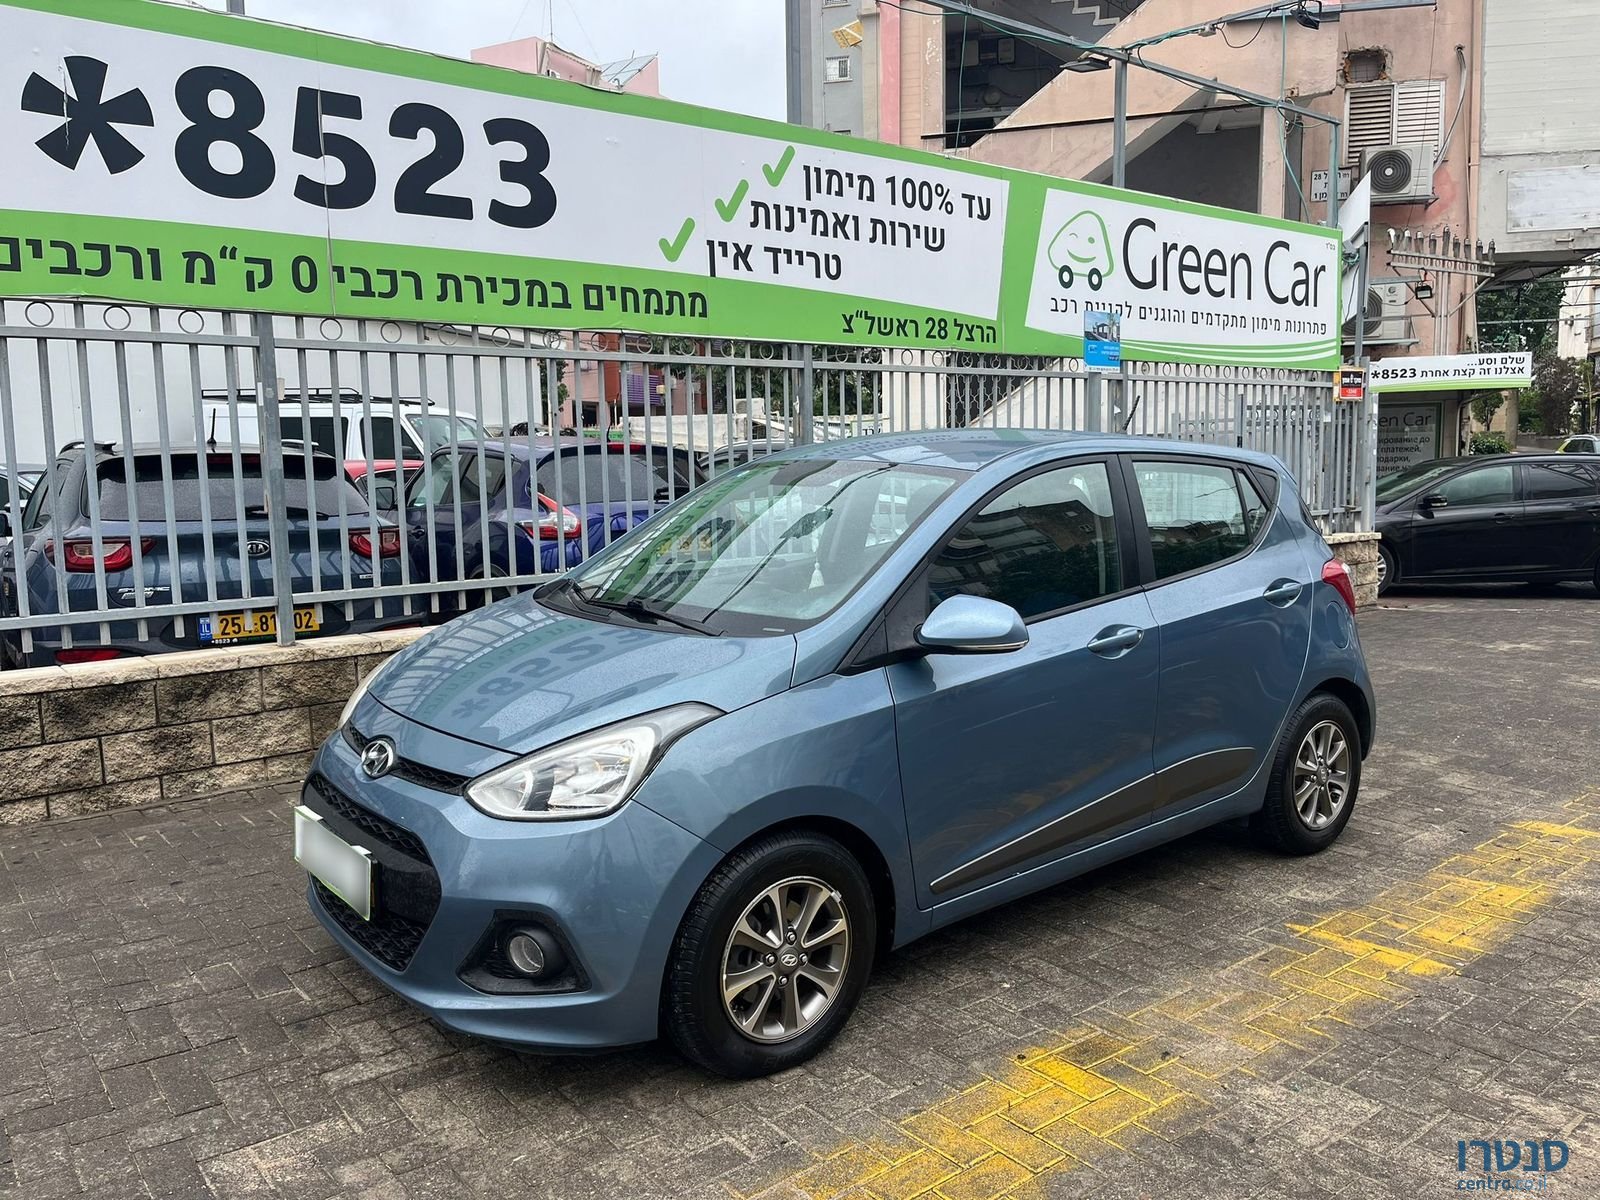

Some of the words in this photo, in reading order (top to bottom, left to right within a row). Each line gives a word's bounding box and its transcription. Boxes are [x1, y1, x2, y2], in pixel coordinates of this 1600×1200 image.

[803, 164, 875, 201] מימון
[885, 176, 954, 215] 100%
[961, 193, 991, 221] עד
[749, 200, 860, 242] ואמינות
[869, 218, 945, 253] שירות
[0, 237, 163, 281] ורכבים
[706, 239, 753, 278] אין
[764, 246, 842, 281] טרייד
[1122, 217, 1252, 300] Green
[1264, 240, 1326, 308] Car
[291, 255, 318, 293] 0
[332, 266, 423, 300] רכבי
[436, 273, 572, 309] במכירת
[582, 283, 708, 318] מתמחים
[1050, 297, 1078, 314] רכב
[1139, 306, 1186, 324] והוגנים
[925, 316, 948, 340] 28
[953, 318, 997, 343] הרצל
[1191, 311, 1247, 331] מתקדמים
[1252, 316, 1281, 333] מימון
[1285, 319, 1327, 335] פתרונות
[1420, 369, 1449, 377] אחרת
[1453, 368, 1475, 378] קצת
[1479, 367, 1491, 375] זה
[1494, 366, 1525, 375] אצלנו
[1500, 356, 1525, 365] שלם
[1403, 412, 1432, 427] Car
[247, 544, 266, 553] KIA
